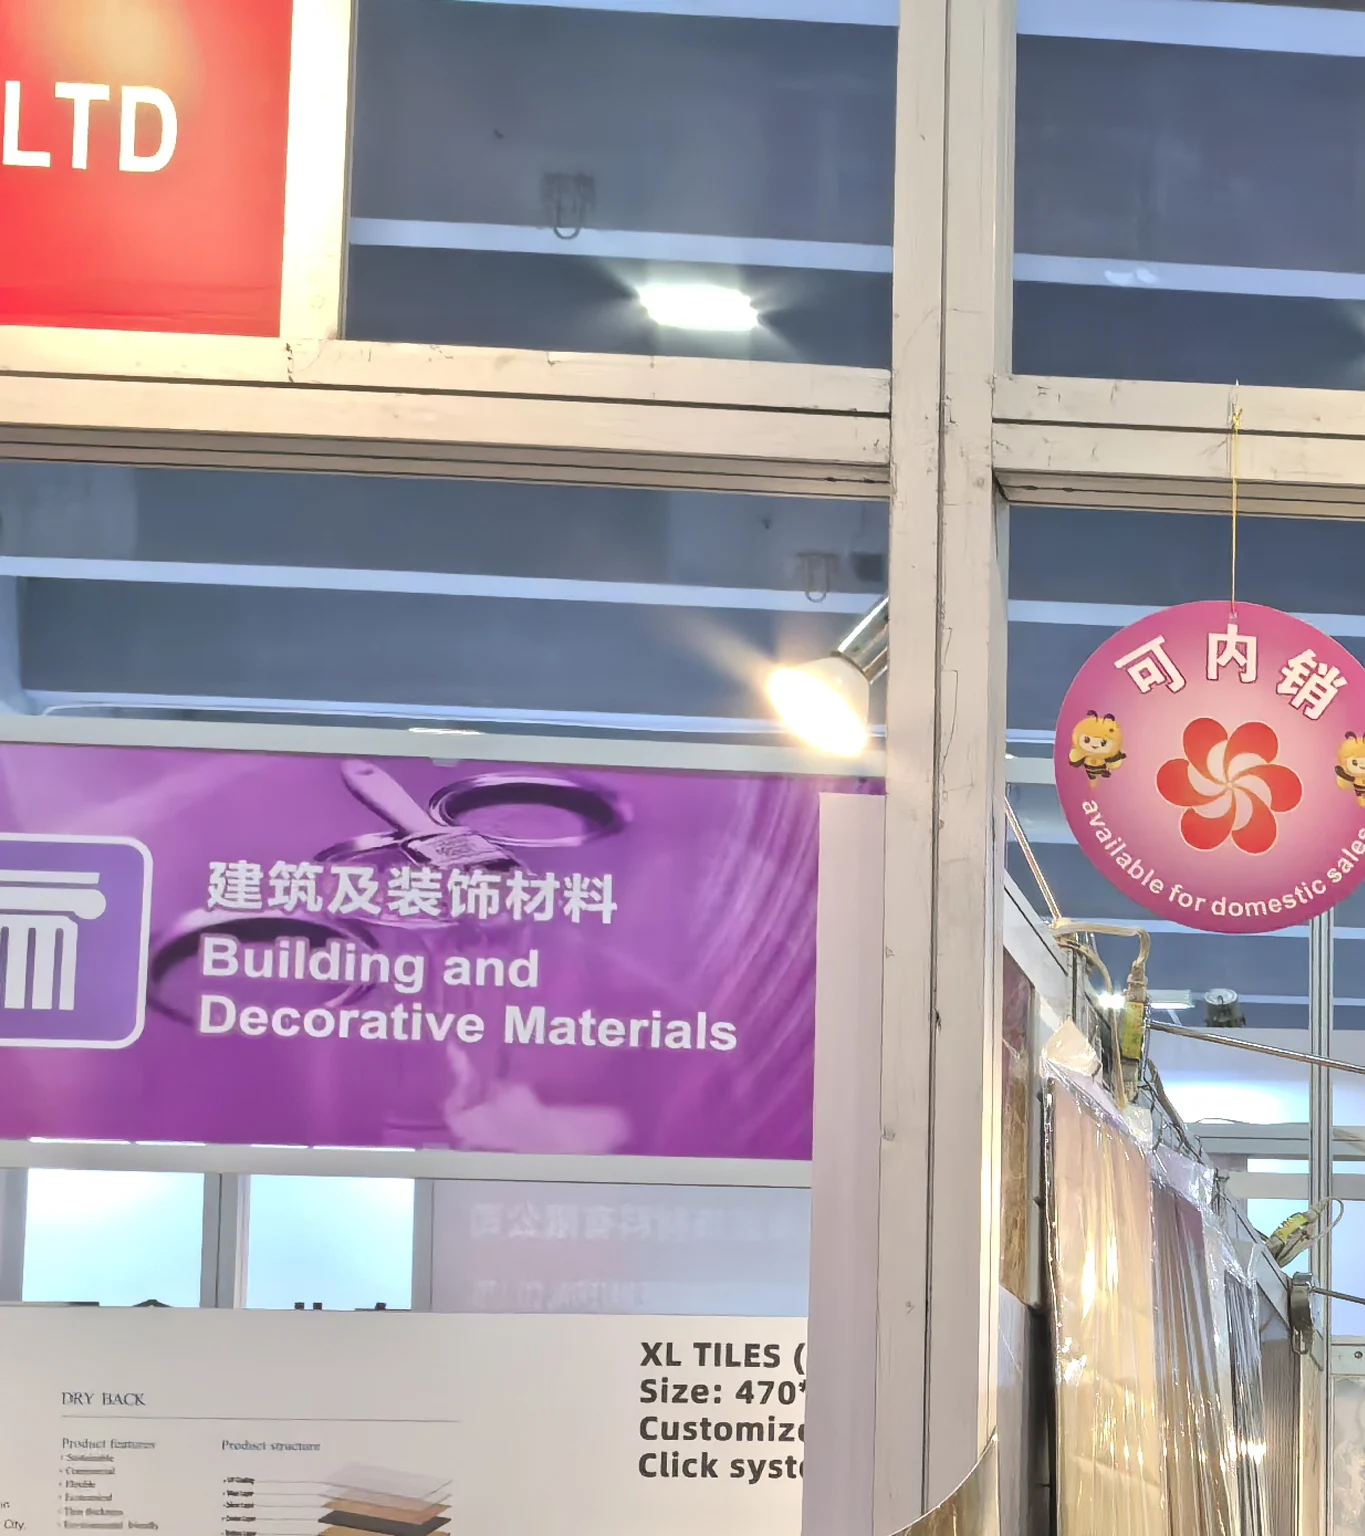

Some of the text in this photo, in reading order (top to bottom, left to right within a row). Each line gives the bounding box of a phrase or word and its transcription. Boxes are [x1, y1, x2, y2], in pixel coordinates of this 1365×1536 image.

[2, 81, 178, 173] LTD
[1114, 623, 1348, 720] 可内销
[1081, 799, 1164, 895] available
[1169, 884, 1206, 912] for
[1211, 878, 1328, 917] domestic
[207, 861, 618, 924] 建筑及装饰材料
[202, 937, 539, 994] Building and
[199, 994, 737, 1052] Decorative Materials
[640, 1342, 681, 1367] XL
[693, 1342, 780, 1368] TILES
[61, 1392, 146, 1406] DRY BACK
[640, 1377, 722, 1404] Size:
[62, 1437, 106, 1449] Product
[221, 1438, 266, 1450] Product
[639, 1451, 804, 1485] Click syst
